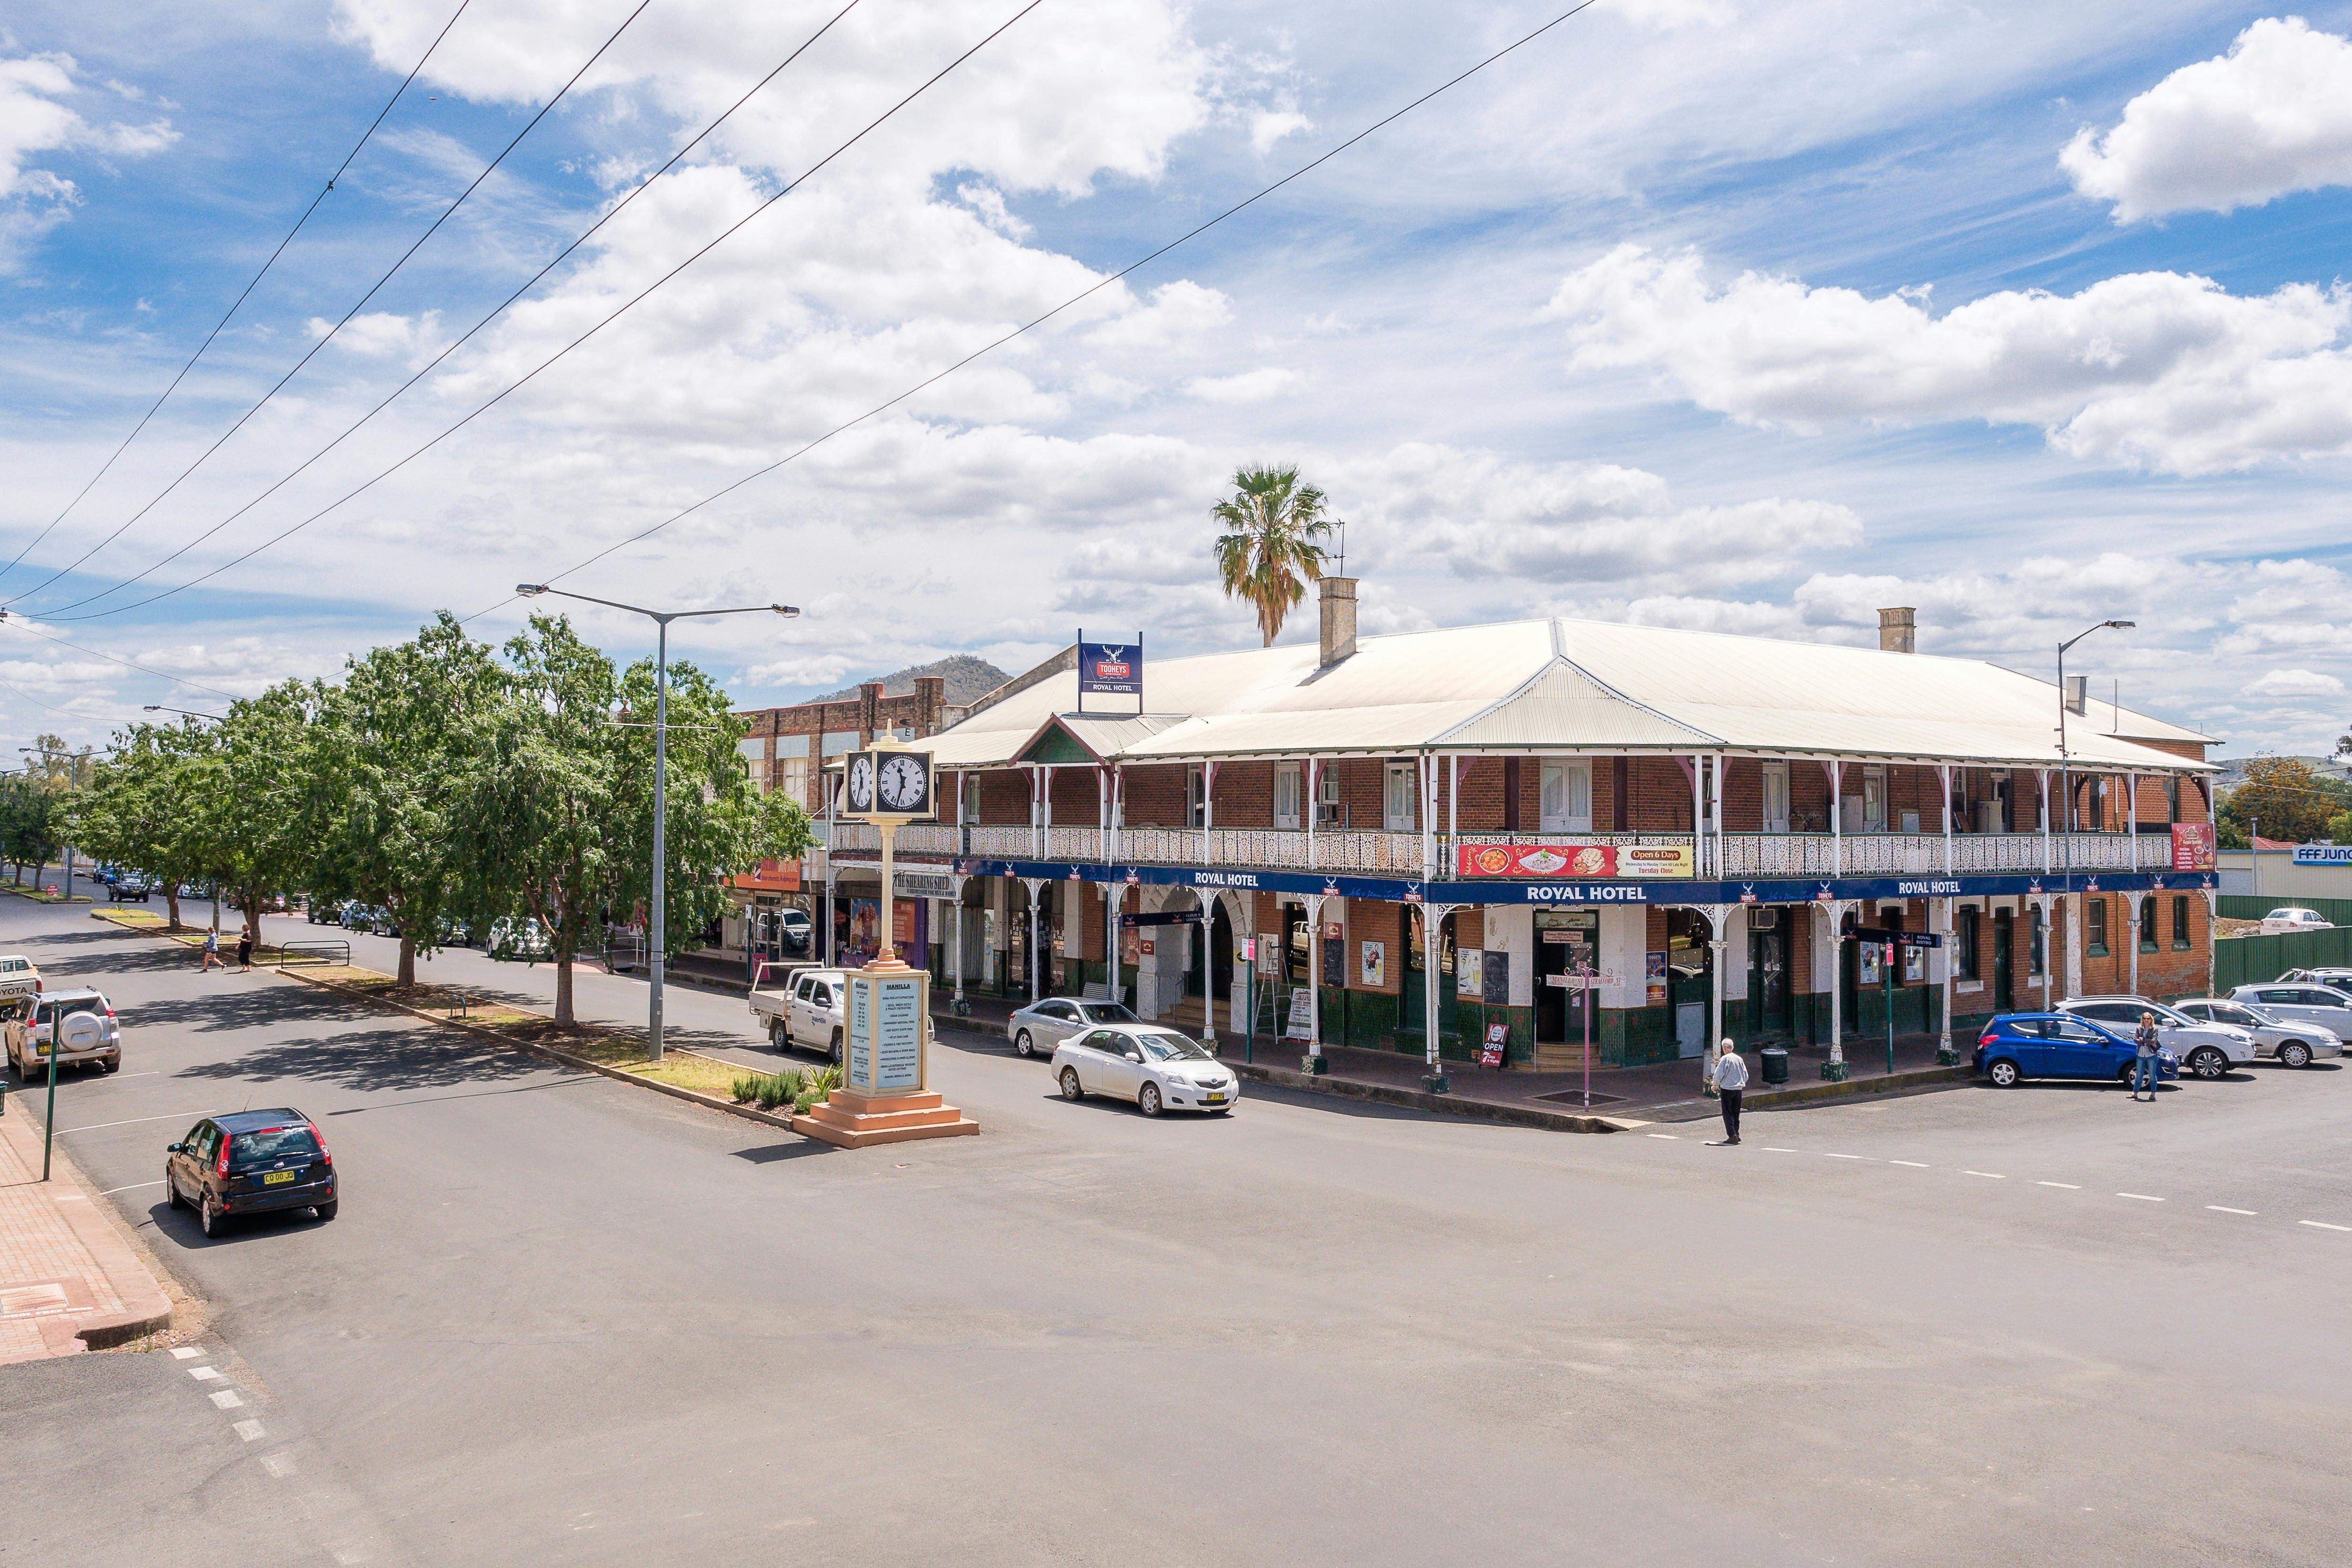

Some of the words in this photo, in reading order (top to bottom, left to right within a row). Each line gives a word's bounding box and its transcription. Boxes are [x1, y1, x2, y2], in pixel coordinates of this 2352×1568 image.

[1100, 665, 1126, 673] TOOHEYS
[1633, 851, 1653, 859] Open
[1662, 851, 1678, 860] Days
[895, 874, 905, 887] THE
[906, 875, 933, 889] SHEARING
[934, 876, 949, 890] SHED
[1195, 872, 1225, 884] ROYAL
[1227, 874, 1259, 886] HOTEL
[1528, 887, 1584, 899] ROYAL
[1590, 887, 1646, 899] HOTEL
[1899, 882, 1929, 894] ROYAL
[1932, 881, 1960, 893] HOTEL
[0, 987, 27, 996] YOTA
[1484, 1042, 1504, 1051] OPEN
[1482, 1051, 1490, 1063] 7
